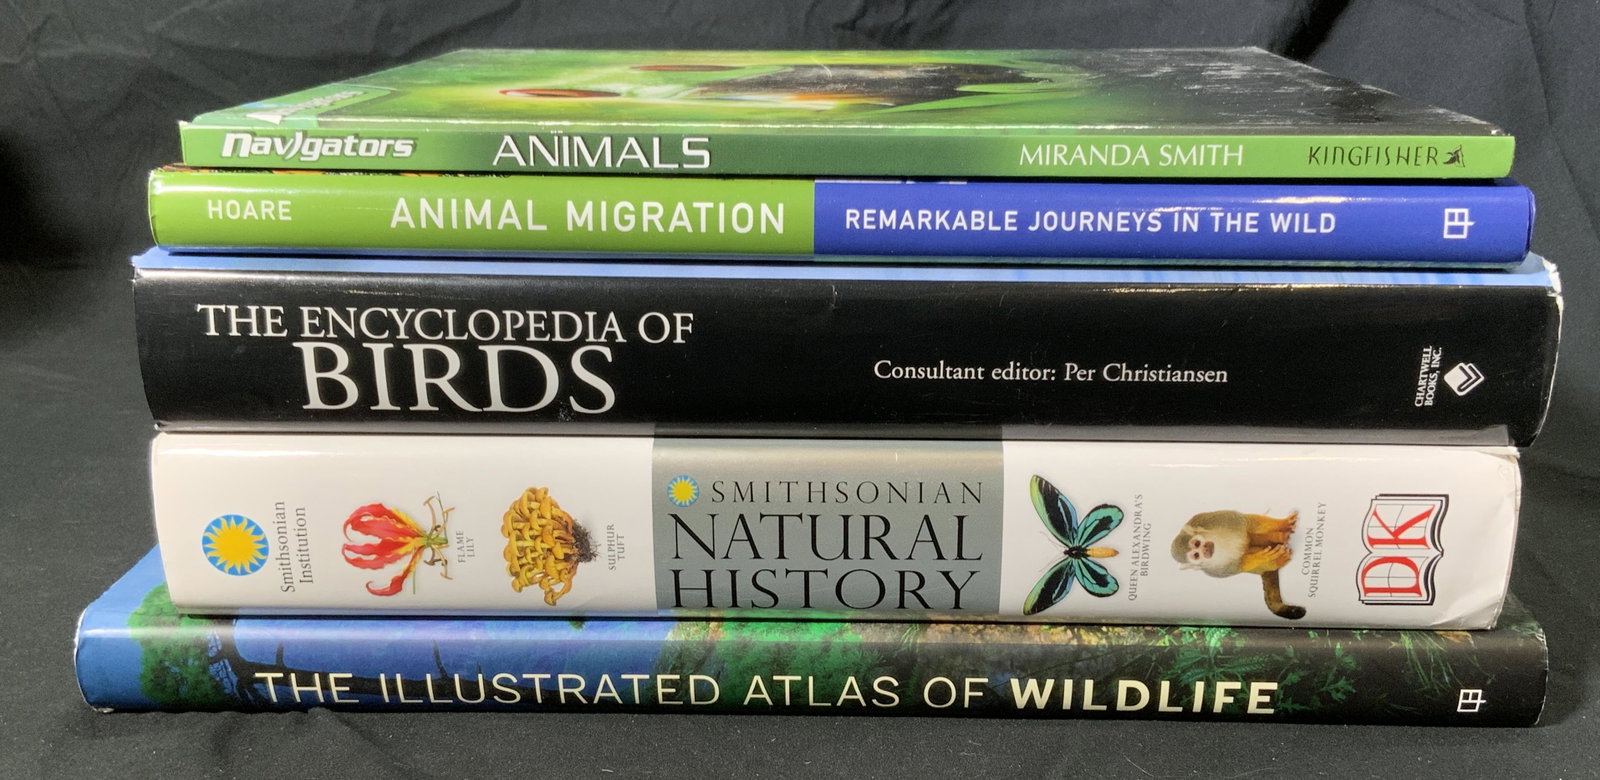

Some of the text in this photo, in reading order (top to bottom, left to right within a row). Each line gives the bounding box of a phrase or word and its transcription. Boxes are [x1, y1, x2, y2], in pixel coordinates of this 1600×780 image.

[492, 135, 711, 168] ANIMALS
[1019, 142, 1245, 167] MIRANDA SMITH
[1308, 145, 1439, 166] KINGFISHER
[207, 198, 293, 221] HOARE
[390, 197, 785, 234] ANIMAL MIGRATION
[845, 208, 1337, 234] REMARKABLE JOURNEYS IN THE WILD
[197, 303, 694, 344] THE ENCYCLOPEDIA OF
[292, 341, 617, 414] BIRDS
[873, 359, 1229, 385] Consultant editor: Per Christiansen
[1414, 346, 1432, 407] CHARTWELL
[1424, 347, 1442, 407] BOOKS, INC.
[711, 480, 984, 505] SMITHSONIAN
[273, 501, 296, 593] Smithsonian
[294, 508, 315, 584] Institution
[456, 529, 465, 563] FLAME
[466, 535, 475, 559] LILY
[606, 524, 616, 571] SULPHUR
[616, 533, 626, 560] TUFT
[668, 513, 984, 562] NATURAL
[1128, 493, 1143, 601] QUEEN ALEXANDRA'S
[1140, 523, 1151, 577] BIRDWING
[1301, 527, 1314, 576] COMMON
[1308, 502, 1327, 598] SQUIRREL MONKEY
[1362, 503, 1436, 597] DK
[671, 568, 981, 611] HISTORY
[254, 672, 1279, 715] THE ILLUSTRATED ATLAS OF WILDLIFE
